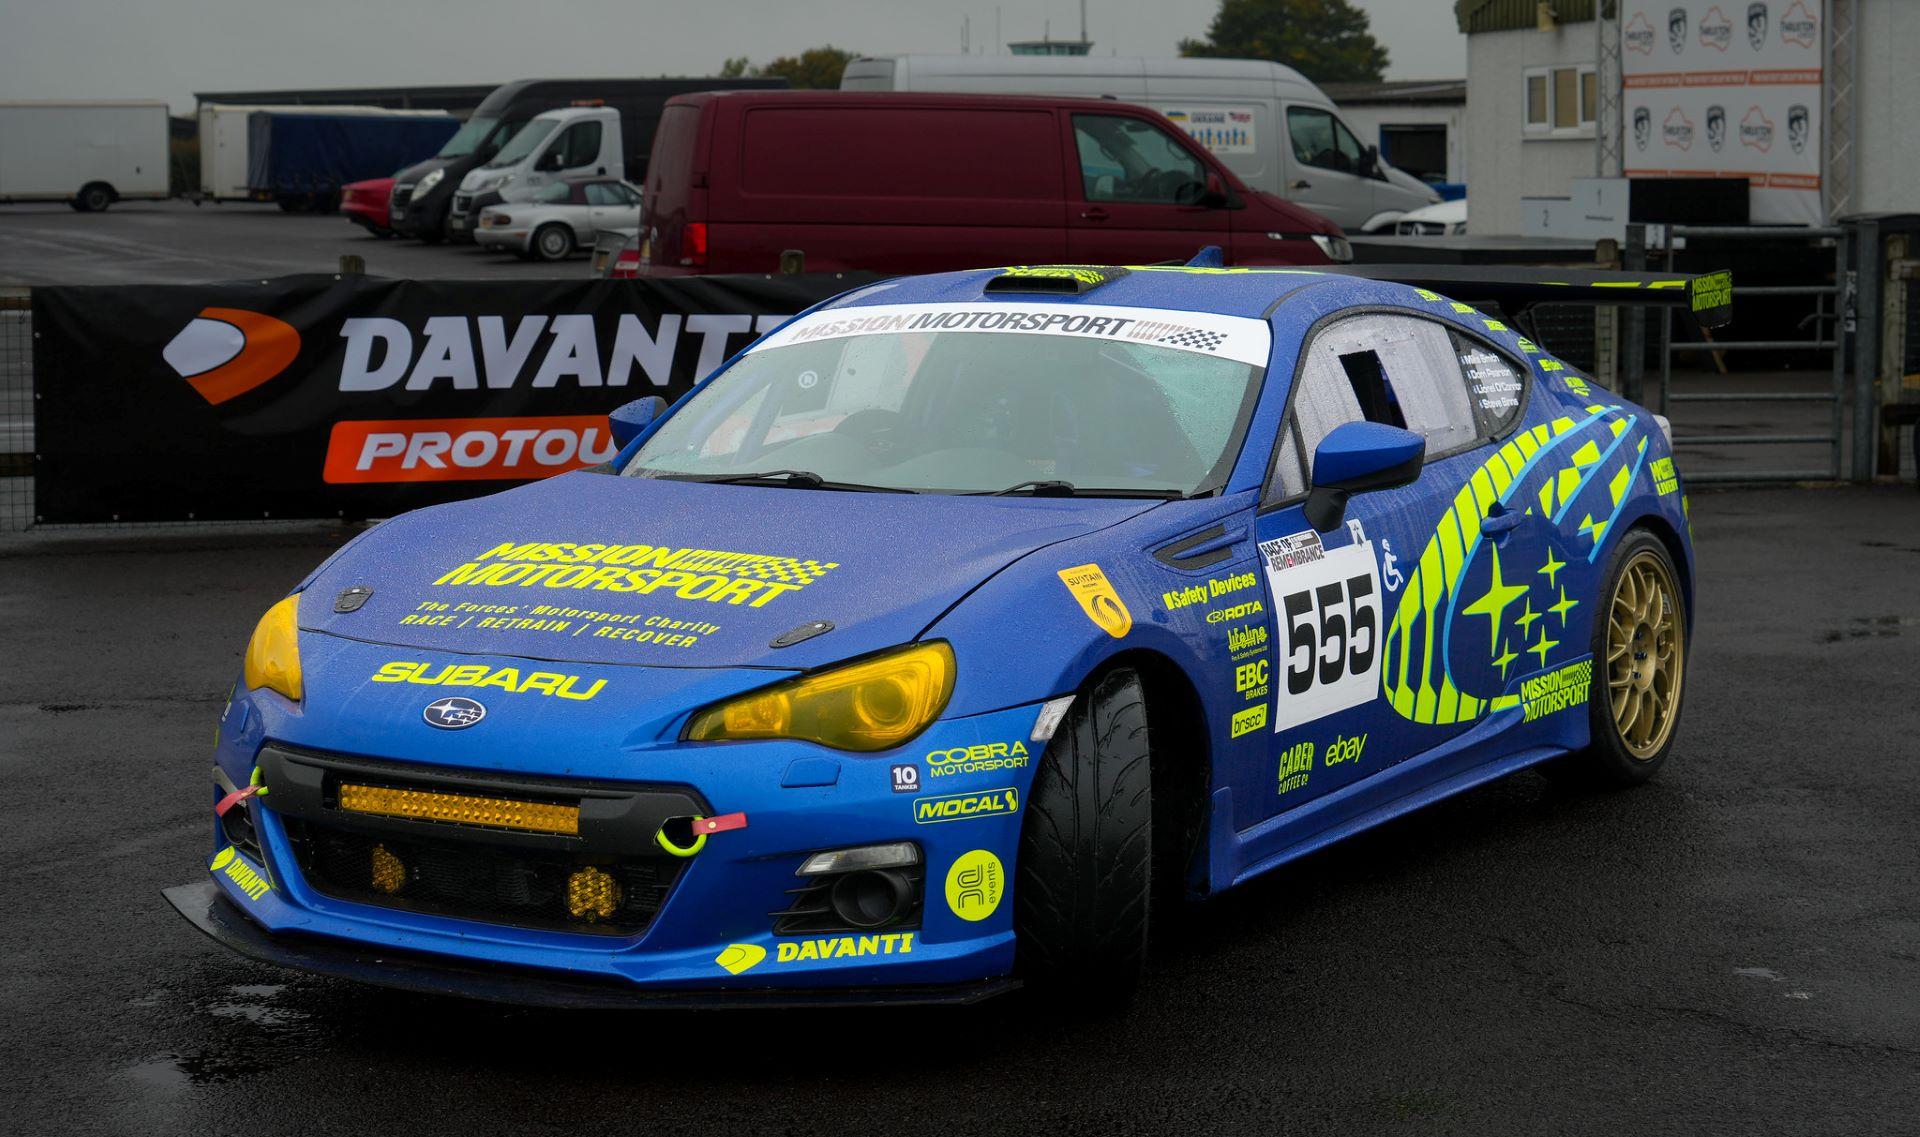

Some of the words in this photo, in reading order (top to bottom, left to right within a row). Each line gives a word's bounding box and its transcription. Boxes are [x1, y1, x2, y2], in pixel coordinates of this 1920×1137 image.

[791, 315, 911, 341] MISSION
[908, 312, 1135, 337] MOTORSPORT
[339, 314, 795, 391] DAVANT
[477, 542, 677, 568] MISSION
[1261, 541, 1283, 557] RACE
[1281, 537, 1293, 552] OF
[1270, 545, 1325, 572] REMEMBRANCE
[432, 563, 808, 608] MOTORSPORT
[1172, 584, 1209, 607] Safety
[1209, 572, 1257, 599] Devices
[416, 602, 448, 613] The
[534, 605, 641, 624] Motorsport
[645, 615, 720, 635] Charity
[1225, 600, 1263, 621] ROTA
[400, 614, 445, 628] RACE
[479, 617, 566, 634] RETRAIN
[599, 626, 699, 648] RECOVER
[1283, 573, 1376, 696] 555
[372, 662, 607, 700] SUBARU
[1236, 659, 1269, 693] EBC
[1245, 684, 1268, 701] BRAKES
[1521, 669, 1563, 703] MISSION
[1522, 680, 1591, 724] MOTORSPORT
[926, 740, 1029, 767] COBRA
[1278, 742, 1314, 781] CABER
[1325, 733, 1368, 767] ebay
[892, 766, 918, 784] 10
[930, 756, 1030, 778] MOTORSPORT
[894, 783, 918, 791] TANKER
[1278, 774, 1301, 795] COFFEE
[919, 795, 1005, 819] MOCAL
[225, 857, 271, 901] DAVANTI
[988, 861, 997, 904] events
[777, 932, 914, 962] DAVANTI
